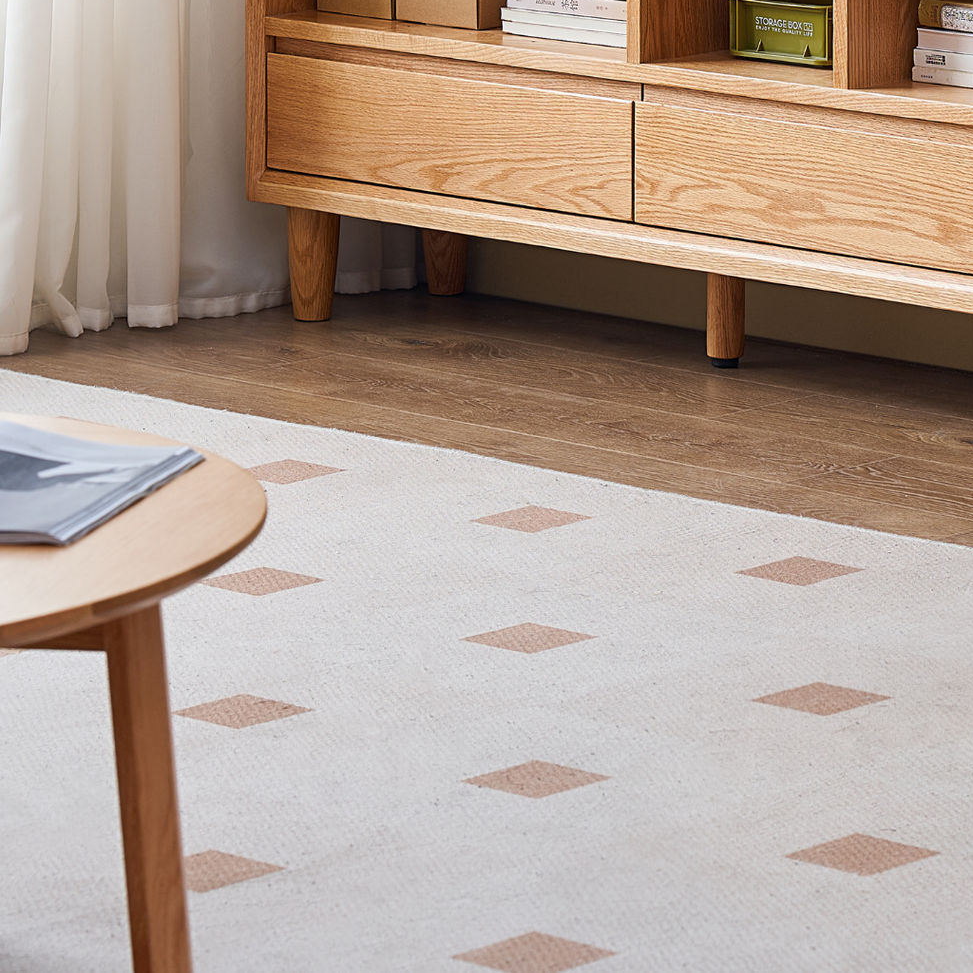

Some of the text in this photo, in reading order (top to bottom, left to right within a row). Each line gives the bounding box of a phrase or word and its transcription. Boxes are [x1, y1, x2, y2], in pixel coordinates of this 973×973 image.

[755, 16, 803, 30] STORAGE BOX
[782, 28, 802, 36] QUALITY
